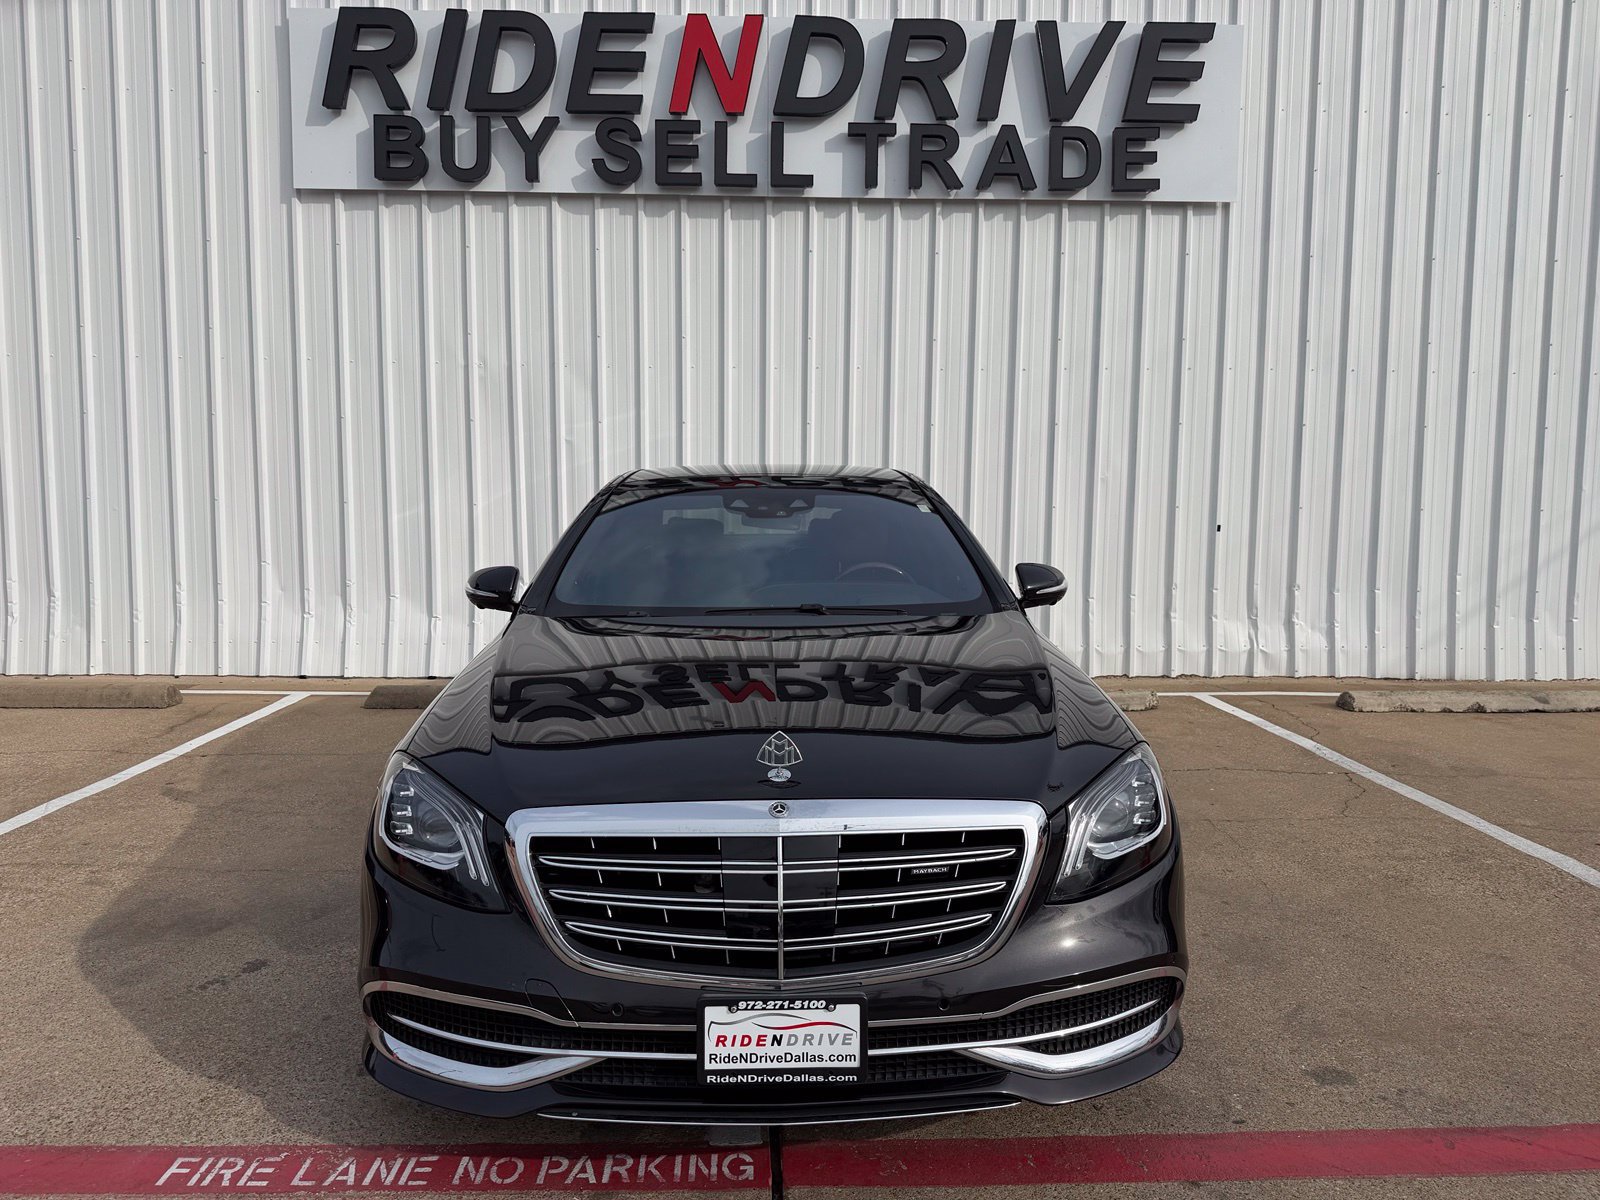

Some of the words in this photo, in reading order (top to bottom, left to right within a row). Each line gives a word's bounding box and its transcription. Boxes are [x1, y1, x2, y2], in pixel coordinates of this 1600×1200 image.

[322, 6, 1216, 125] RIDENDRIVE
[373, 114, 560, 184] BUY
[591, 117, 814, 189] SELL
[847, 122, 1161, 193] TRADE
[738, 1000, 826, 1010] 972-271-5100
[715, 1033, 854, 1048] RIDENDRIVE
[708, 1052, 857, 1064] RideNDriveDallas.com
[706, 1073, 858, 1083] RideNDriveDallas.com
[155, 1155, 282, 1187] FIRE
[290, 1155, 440, 1187] LANE
[452, 1155, 525, 1185] NO
[536, 1152, 754, 1184] PARKING
